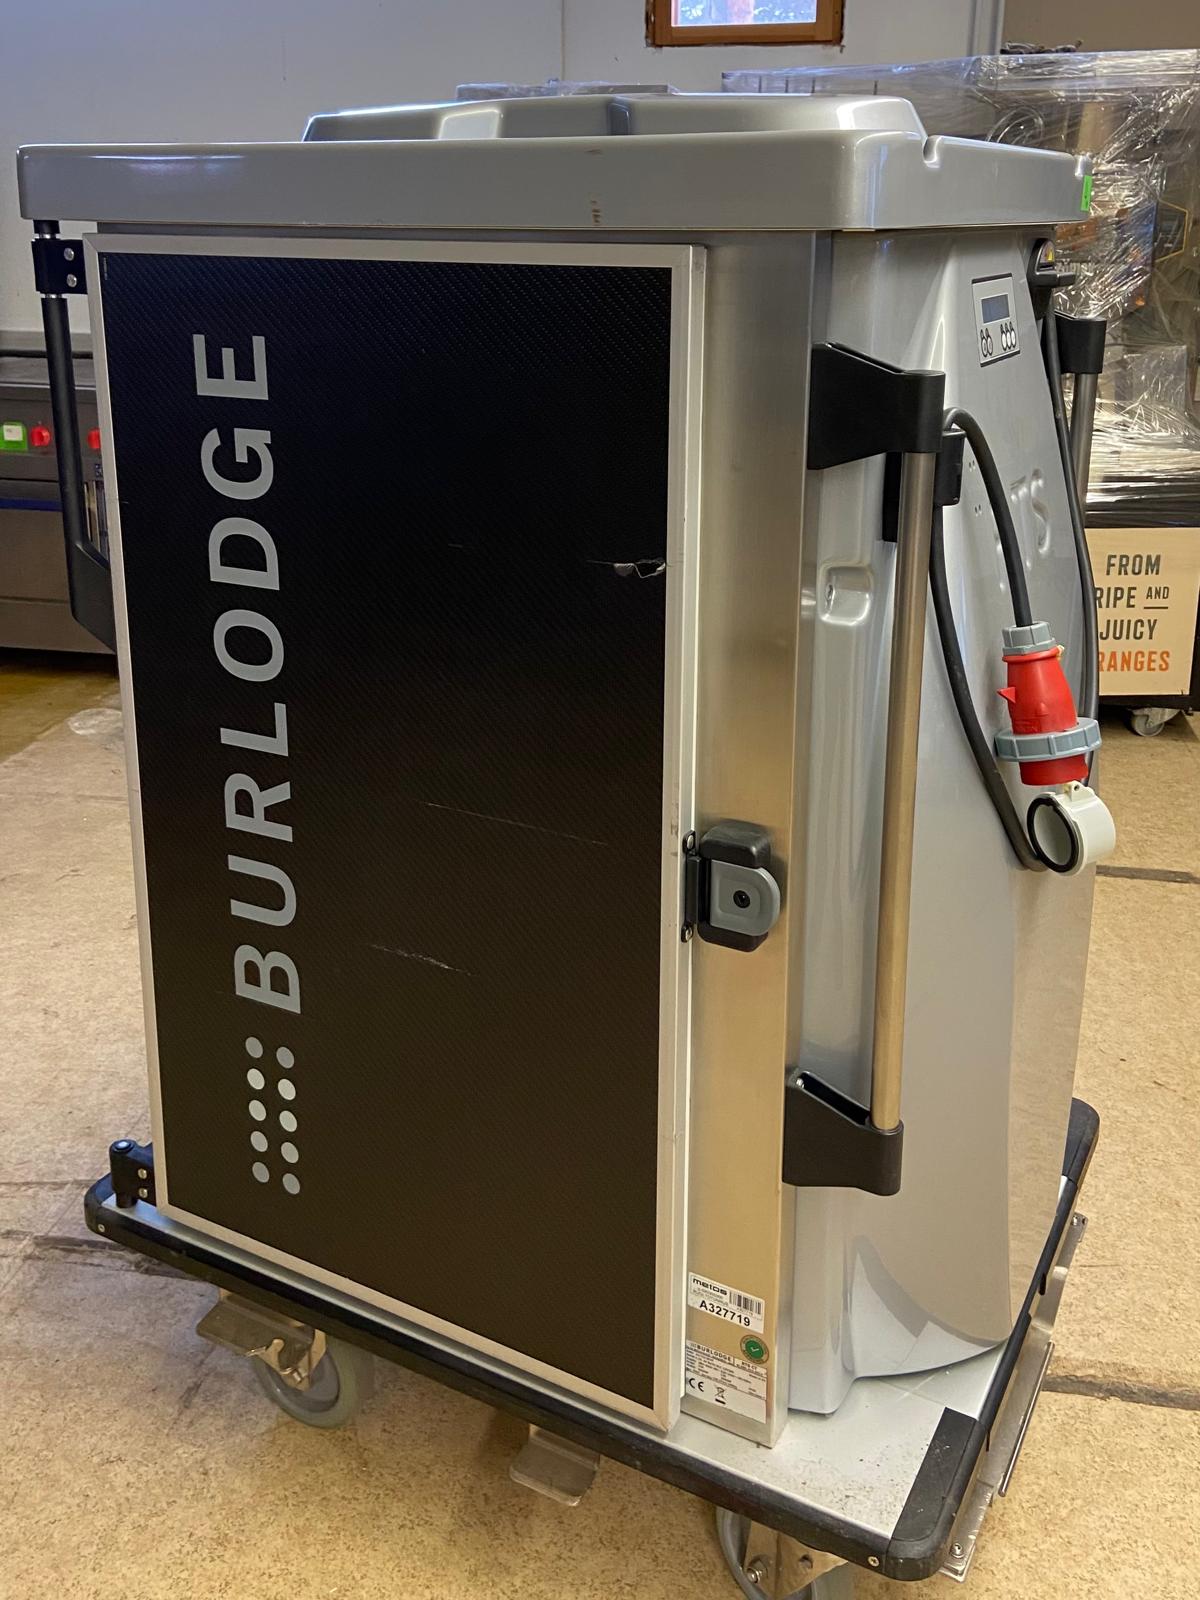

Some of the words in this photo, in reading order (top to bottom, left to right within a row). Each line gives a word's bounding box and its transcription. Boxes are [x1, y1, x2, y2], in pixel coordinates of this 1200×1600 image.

[1106, 554, 1161, 575] FROM
[1145, 586, 1170, 599] AND
[1099, 618, 1158, 640] JUICY
[1098, 650, 1170, 672] RANGES
[193, 334, 301, 1014] BURLODGE
[692, 1278, 728, 1296] metos
[699, 1300, 751, 1327] A327719
[698, 1344, 732, 1361] BURLODGE
